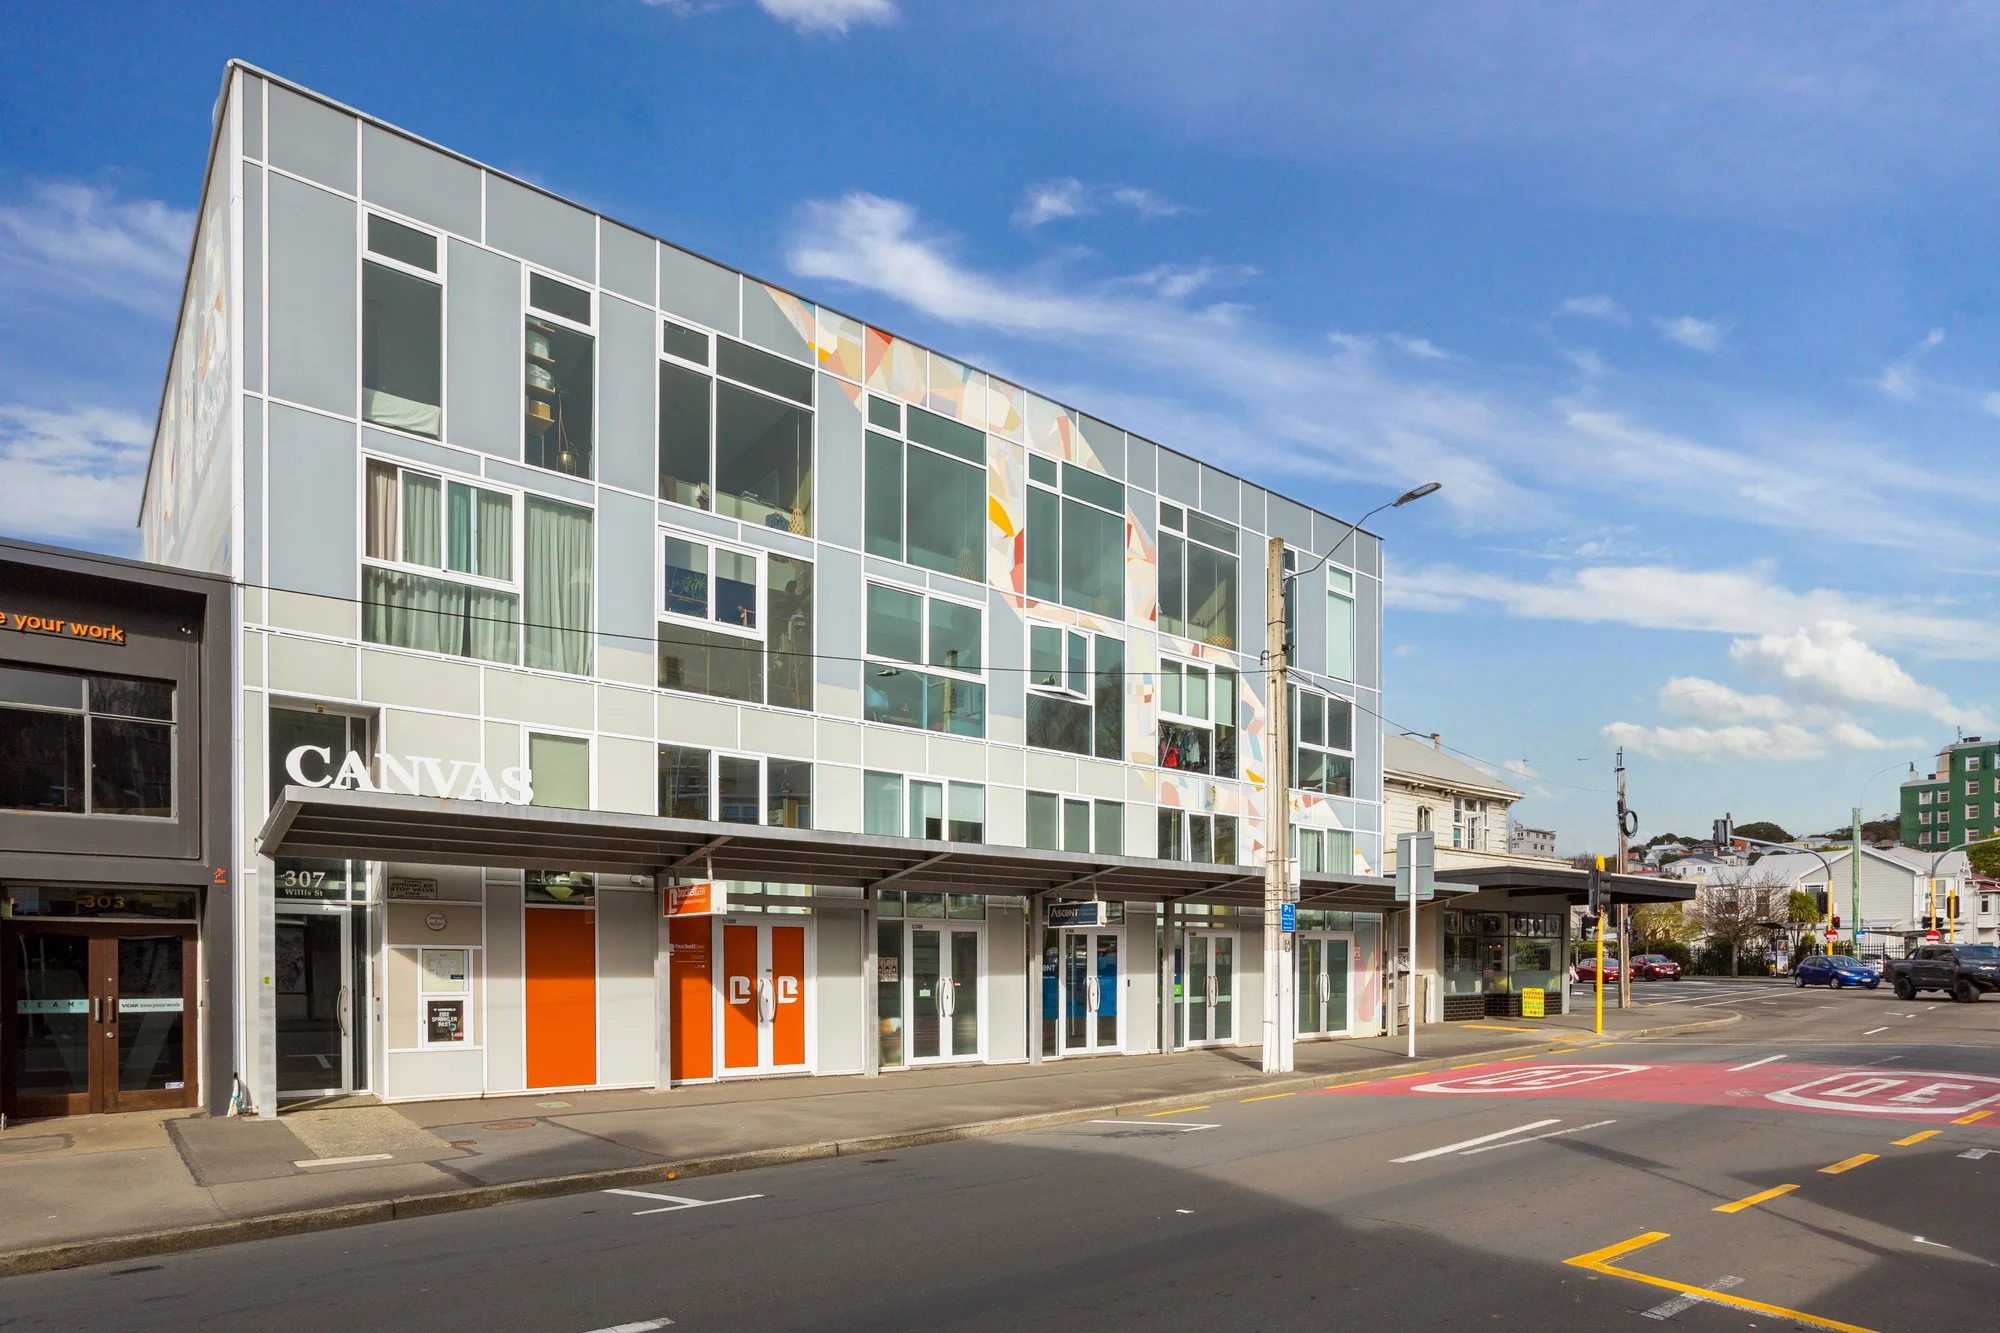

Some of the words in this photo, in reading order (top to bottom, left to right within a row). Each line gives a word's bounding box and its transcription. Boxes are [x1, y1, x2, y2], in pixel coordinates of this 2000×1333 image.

[13, 614, 64, 632] your
[70, 622, 124, 641] work
[285, 745, 534, 806] CANVAS
[284, 870, 326, 888] 307
[285, 888, 312, 896] Willis
[84, 895, 125, 908] 303
